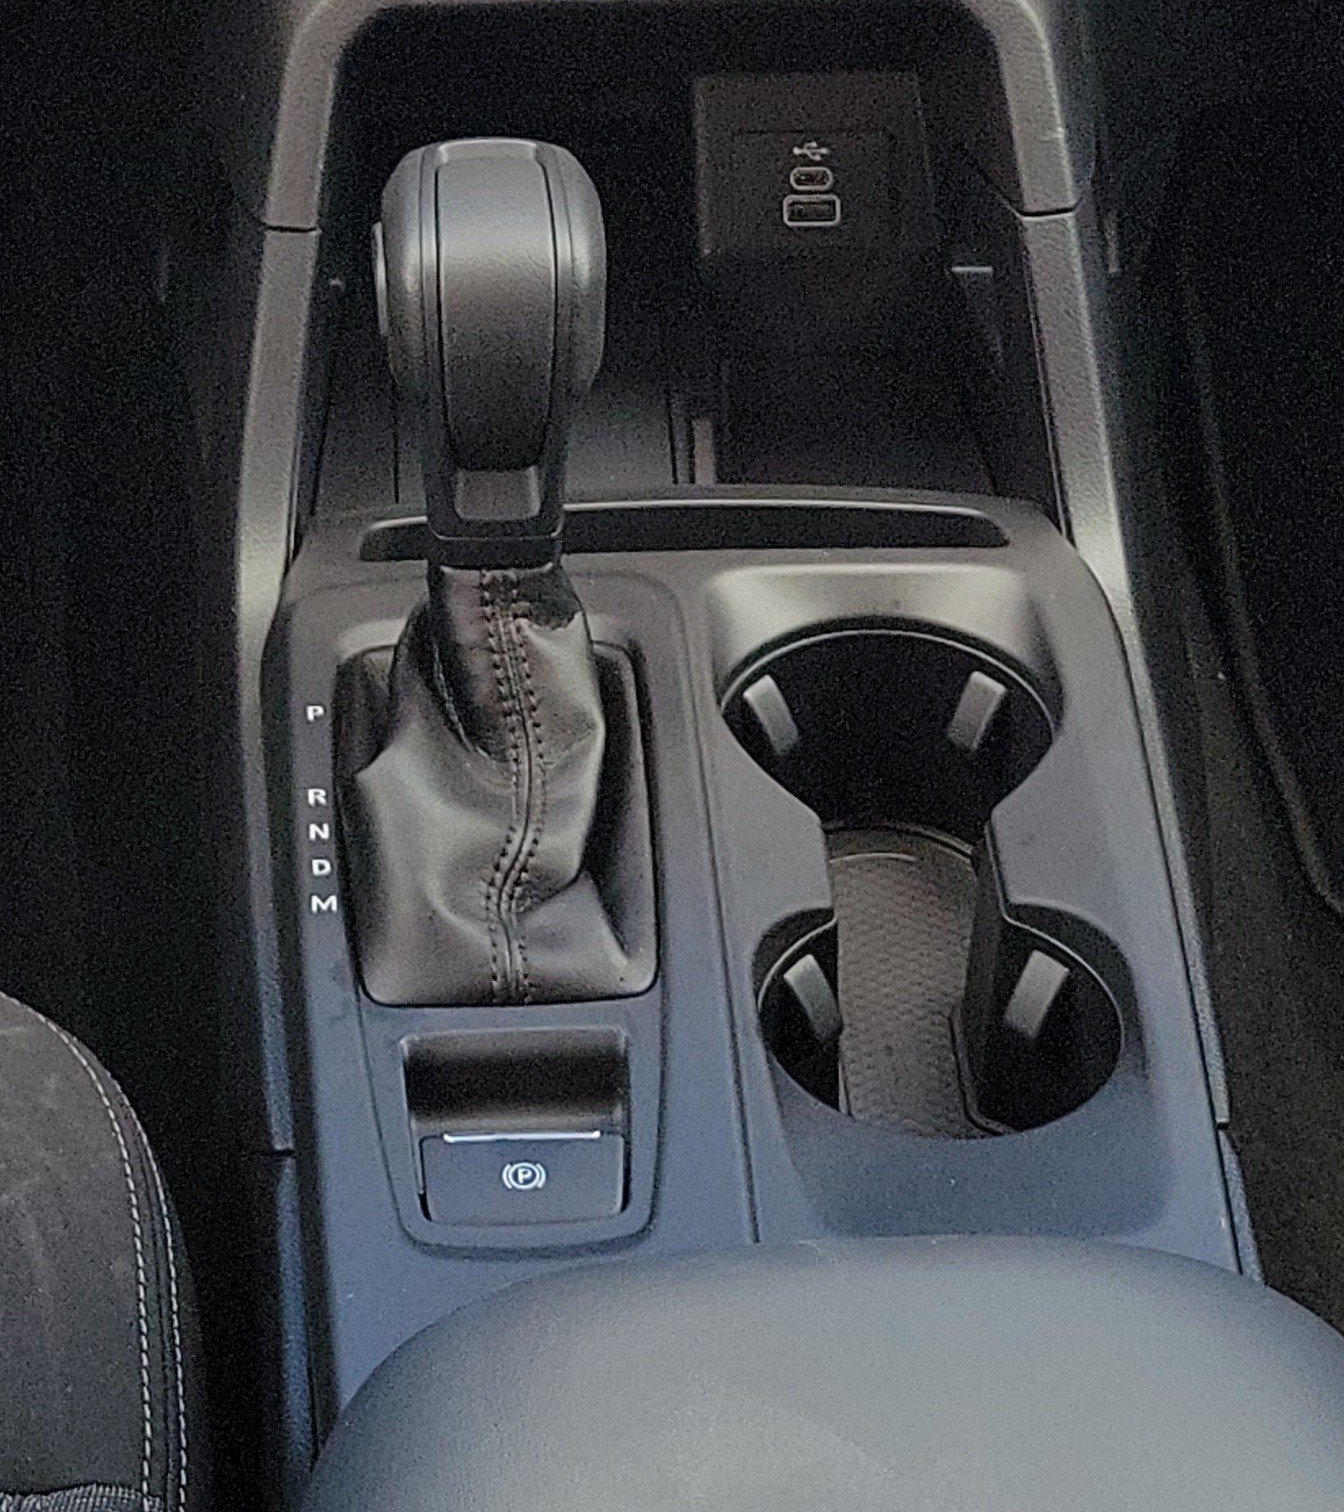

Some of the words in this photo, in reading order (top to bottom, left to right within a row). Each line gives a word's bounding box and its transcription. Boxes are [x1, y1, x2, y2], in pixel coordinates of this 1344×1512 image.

[306, 705, 325, 722] P
[307, 788, 327, 806] R
[309, 823, 330, 839] N
[311, 859, 332, 876] D
[311, 895, 338, 913] M
